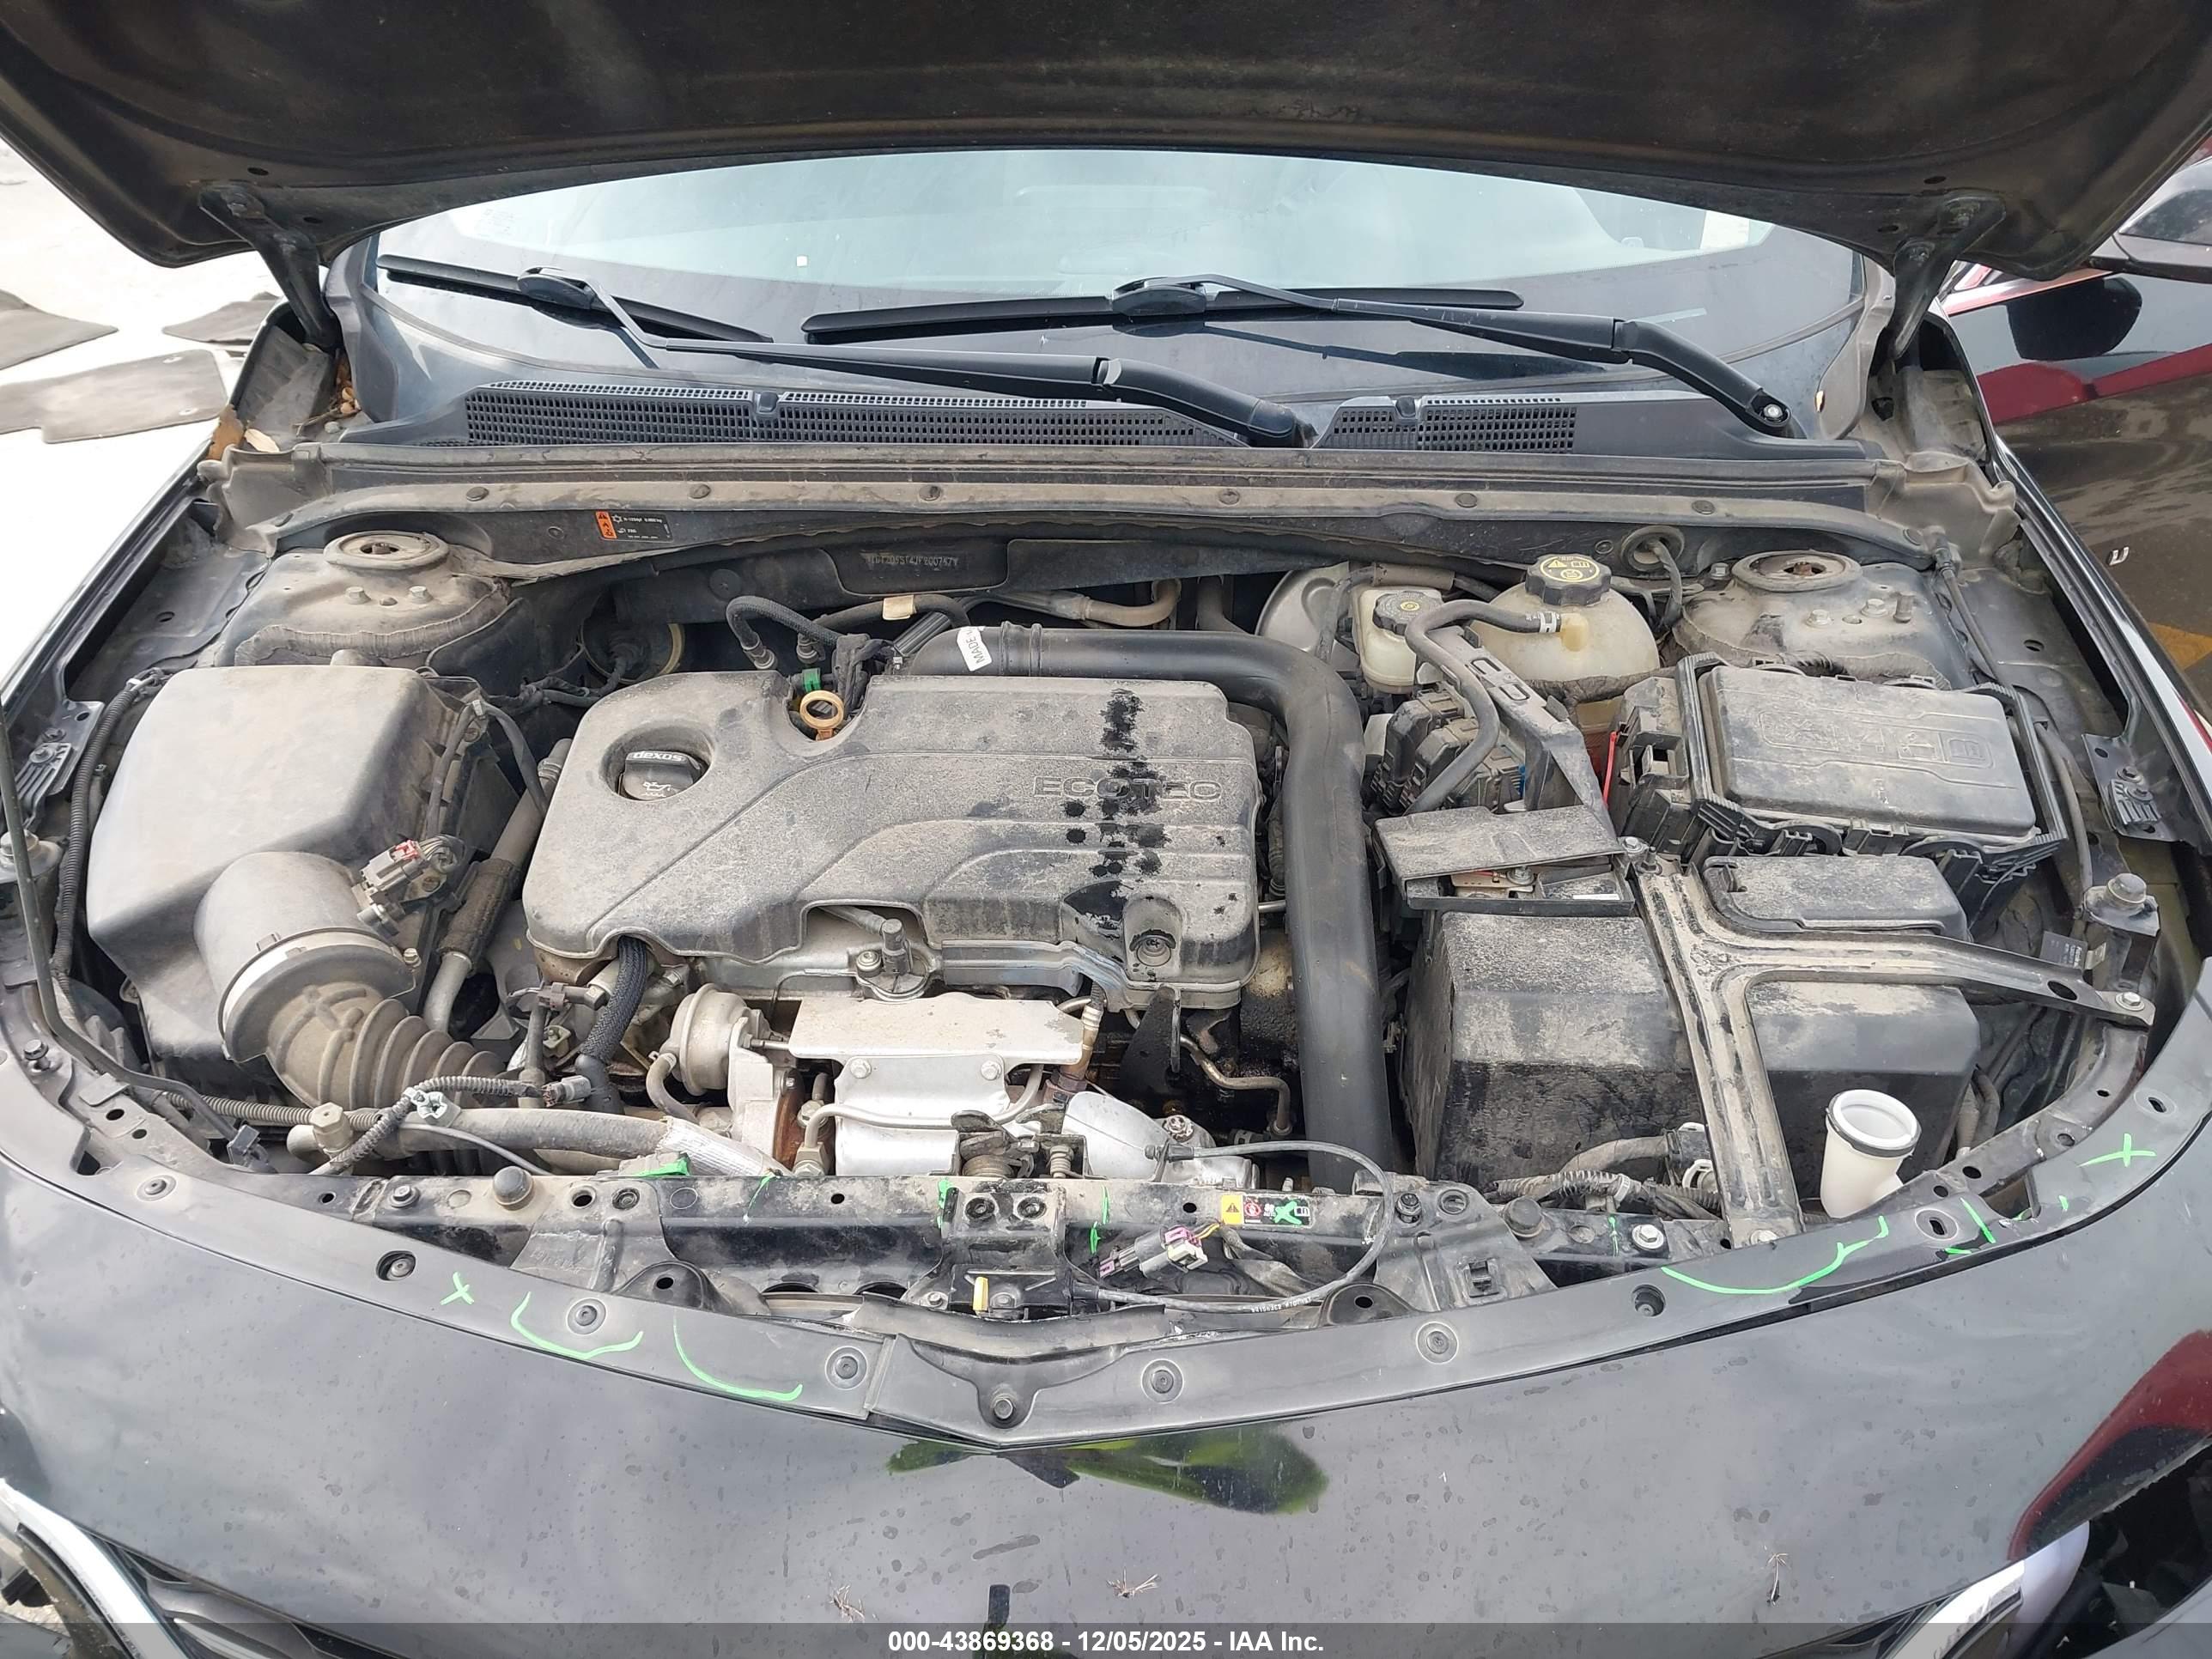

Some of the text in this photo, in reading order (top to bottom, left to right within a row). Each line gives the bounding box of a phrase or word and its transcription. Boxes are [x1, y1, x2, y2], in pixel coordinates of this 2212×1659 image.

[966, 636, 985, 663] MADE
[634, 751, 682, 762] dexos
[1033, 775, 1224, 803] ECOTEC
